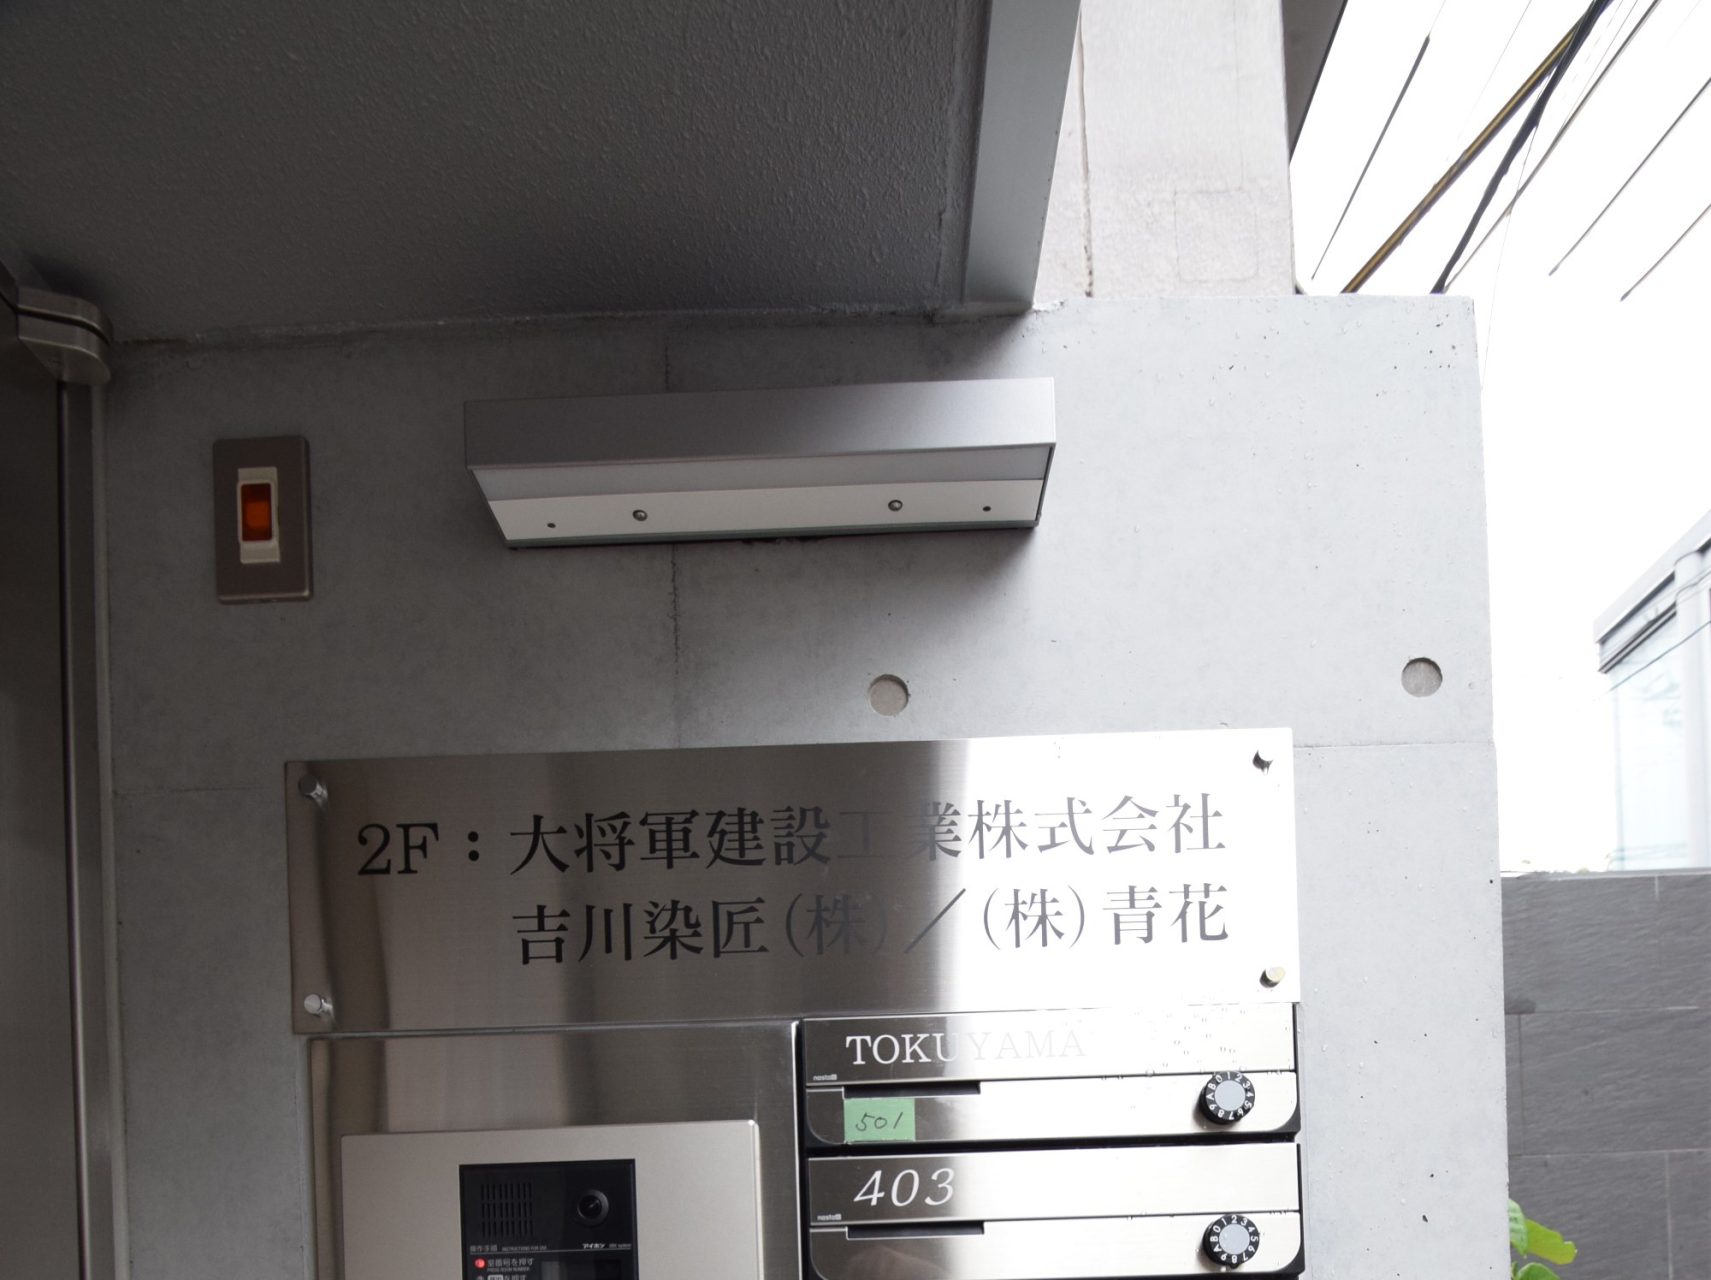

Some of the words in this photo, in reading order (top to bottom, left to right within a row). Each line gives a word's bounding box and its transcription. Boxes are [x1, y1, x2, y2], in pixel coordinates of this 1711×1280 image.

[846, 1030, 1087, 1065] TOKUYAMA
[855, 1111, 904, 1132] 501
[853, 1168, 955, 1208] 403
